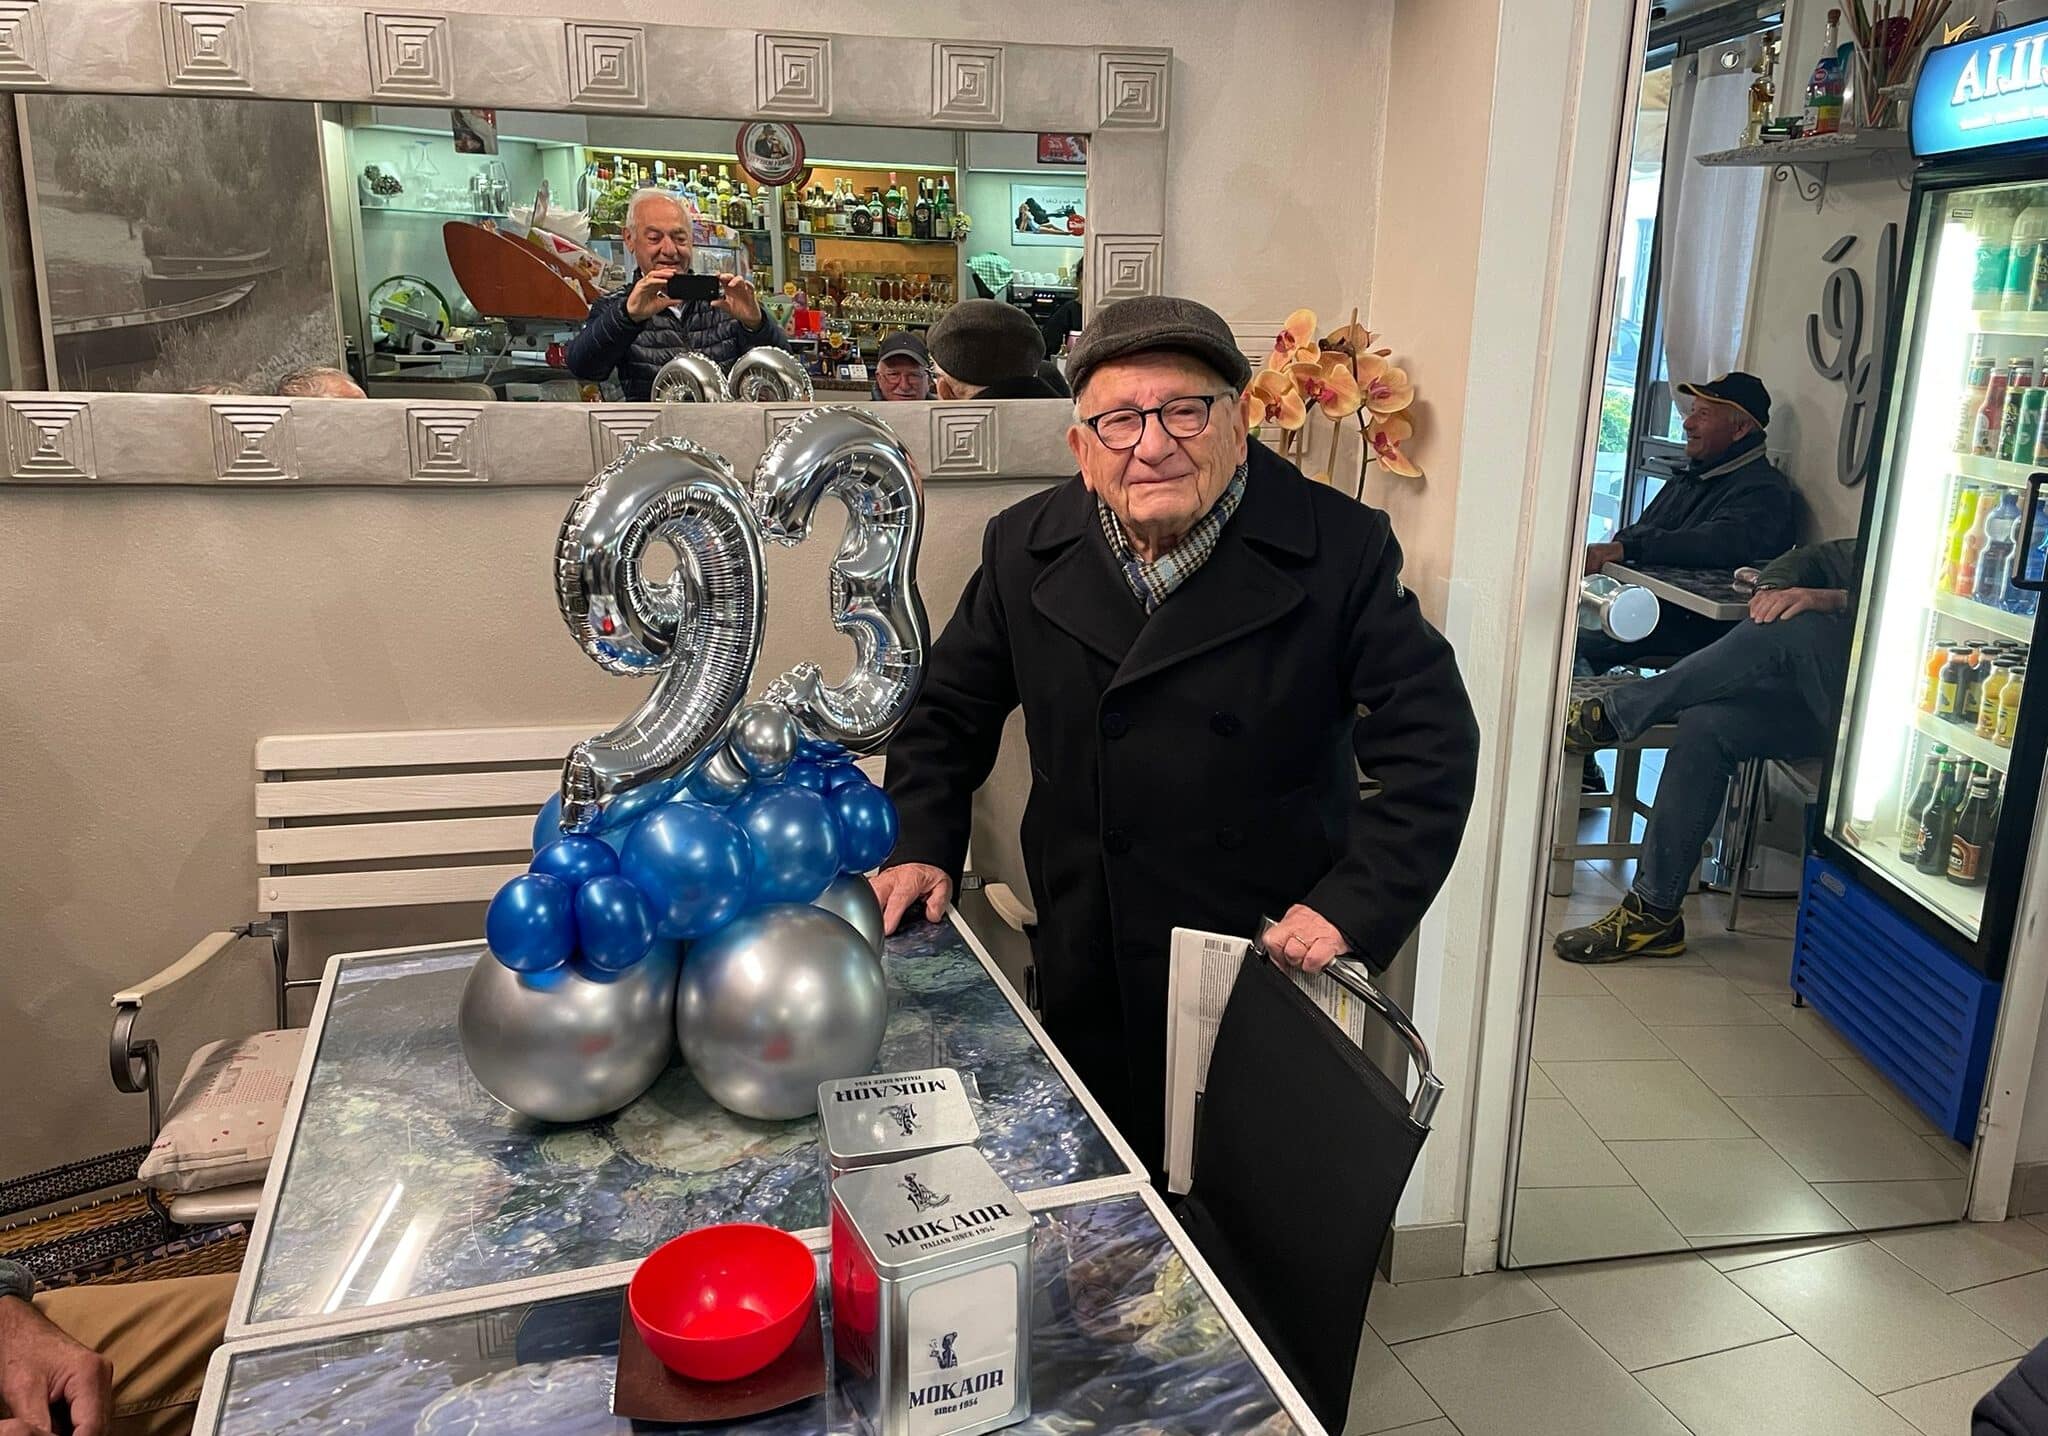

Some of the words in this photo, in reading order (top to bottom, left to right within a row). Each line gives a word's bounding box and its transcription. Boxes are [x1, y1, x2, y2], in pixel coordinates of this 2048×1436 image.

[554, 405, 930, 835] 93
[835, 1079, 947, 1102] MOKAOR
[883, 1203, 1013, 1248] MOKAOR
[920, 1238, 950, 1250] ITALIAN
[951, 1231, 974, 1241] SINCE
[975, 1225, 996, 1236] 1954
[909, 1369, 1004, 1410] MOKAOR
[959, 1397, 978, 1410] 1954
